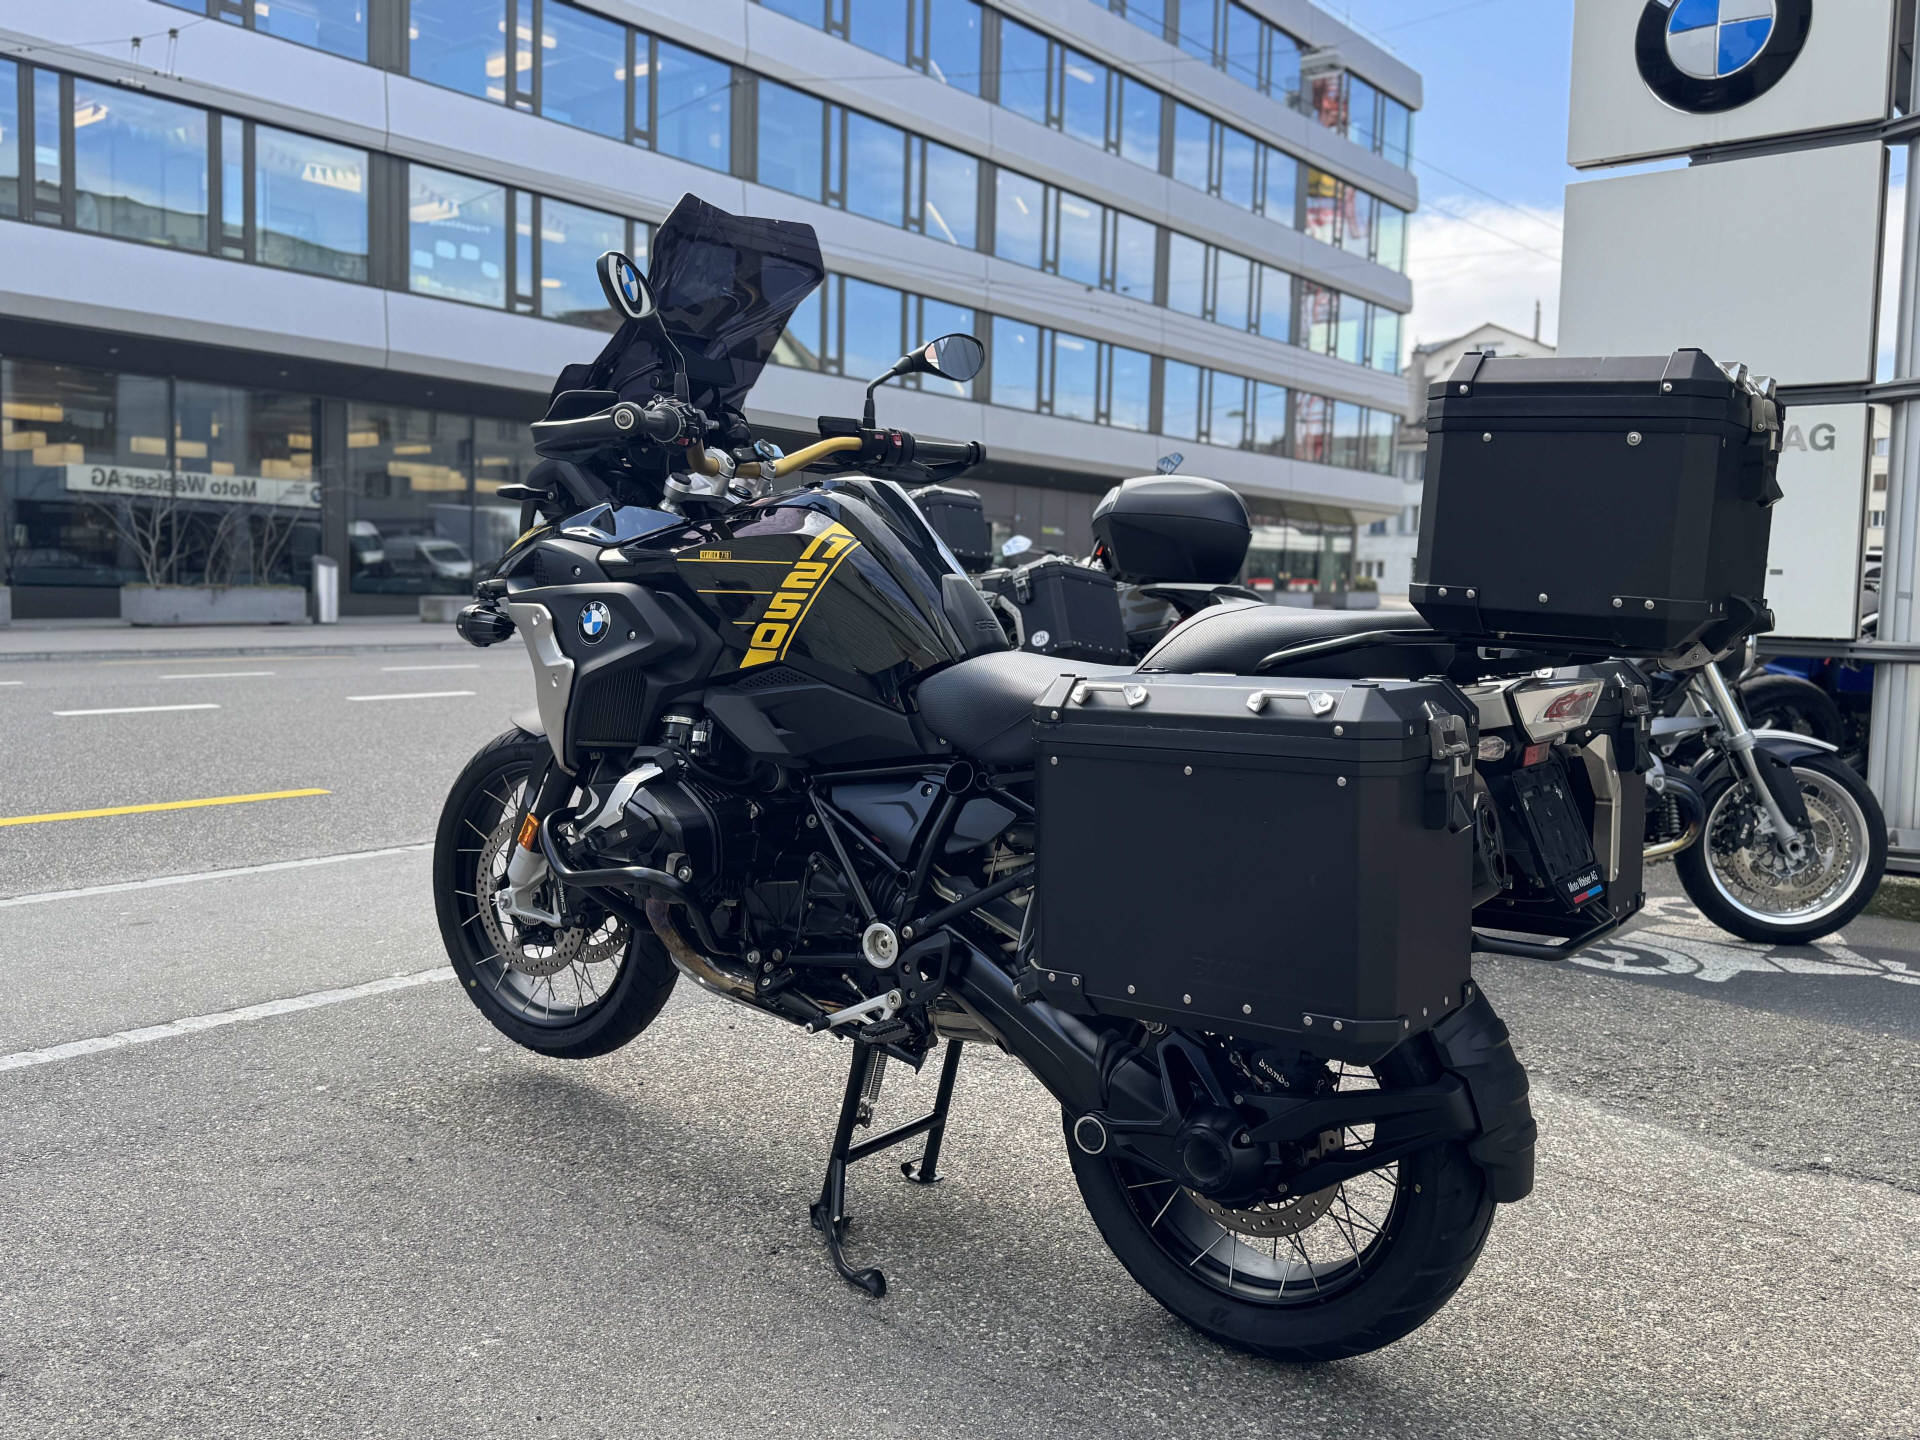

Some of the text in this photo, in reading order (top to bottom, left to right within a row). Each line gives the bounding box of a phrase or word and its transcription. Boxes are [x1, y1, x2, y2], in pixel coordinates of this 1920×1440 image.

[1783, 423, 1836, 452] AG
[750, 535, 854, 649] 1250
[1258, 1058, 1290, 1088] brembo
